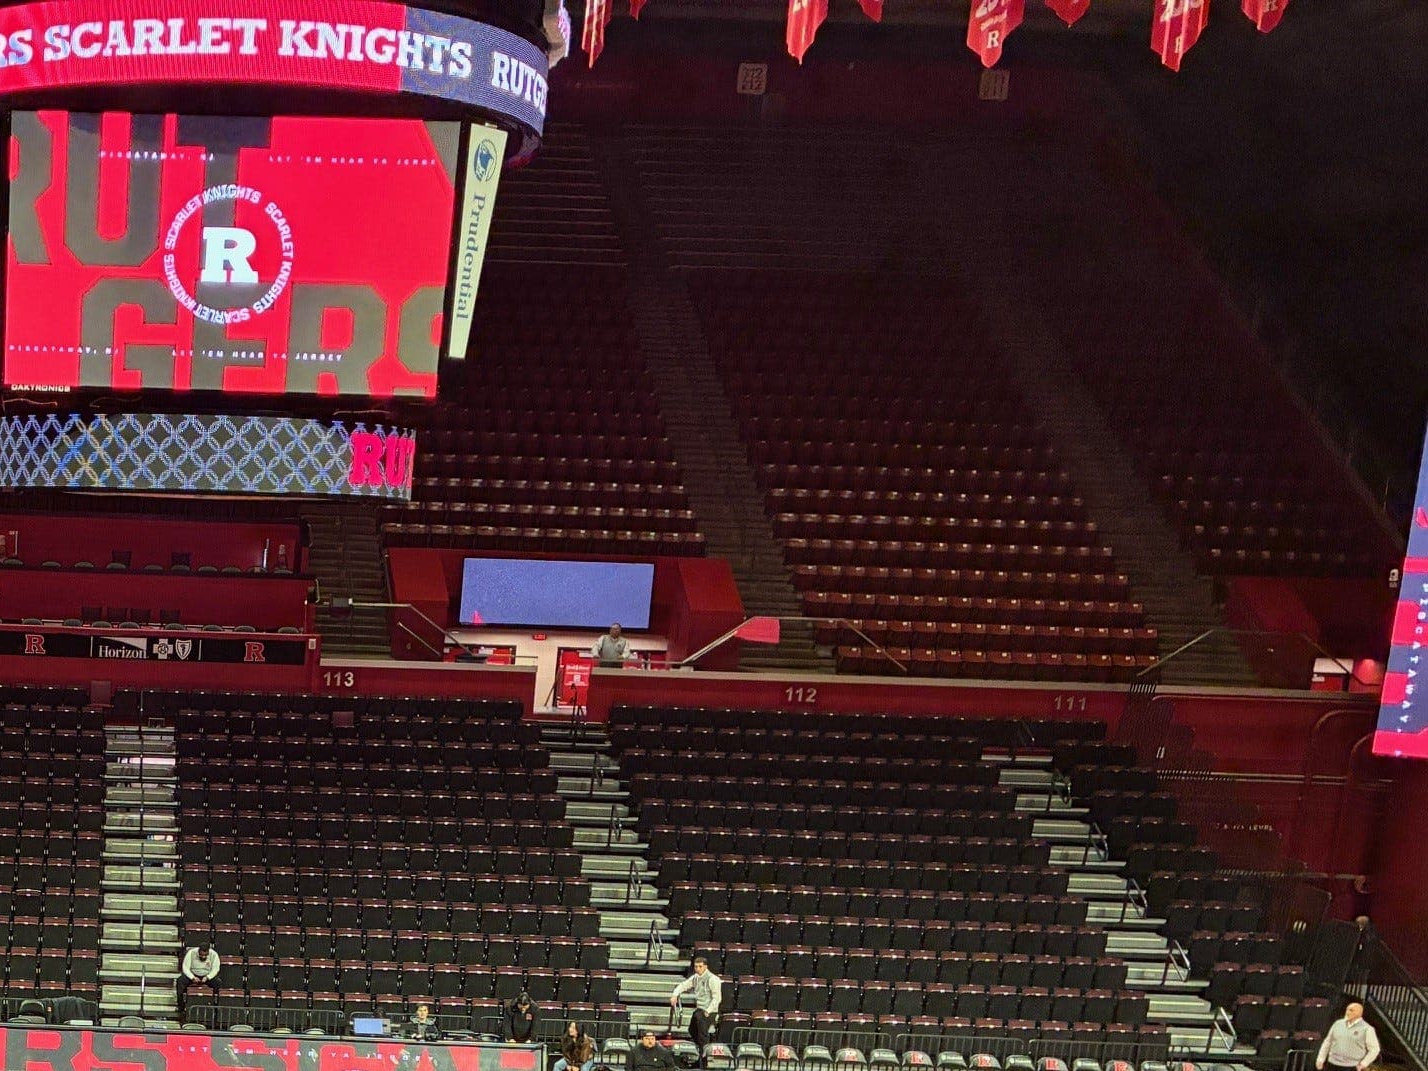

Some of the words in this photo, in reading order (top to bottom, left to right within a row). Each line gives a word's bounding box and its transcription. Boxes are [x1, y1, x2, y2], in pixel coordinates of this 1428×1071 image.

[44, 18, 267, 63] SCARLET
[278, 20, 472, 78] KNIGHTS
[202, 184, 262, 204] KNIGHTS
[265, 202, 294, 258] SCARLET
[200, 227, 258, 283] R
[456, 191, 486, 320] Prudential
[253, 261, 293, 314] KNIGHTS
[25, 634, 46, 654] R
[99, 645, 148, 659] Horizon
[244, 642, 266, 662] R
[323, 671, 354, 687] 113
[785, 687, 817, 703] 112
[1054, 695, 1087, 711] 111
